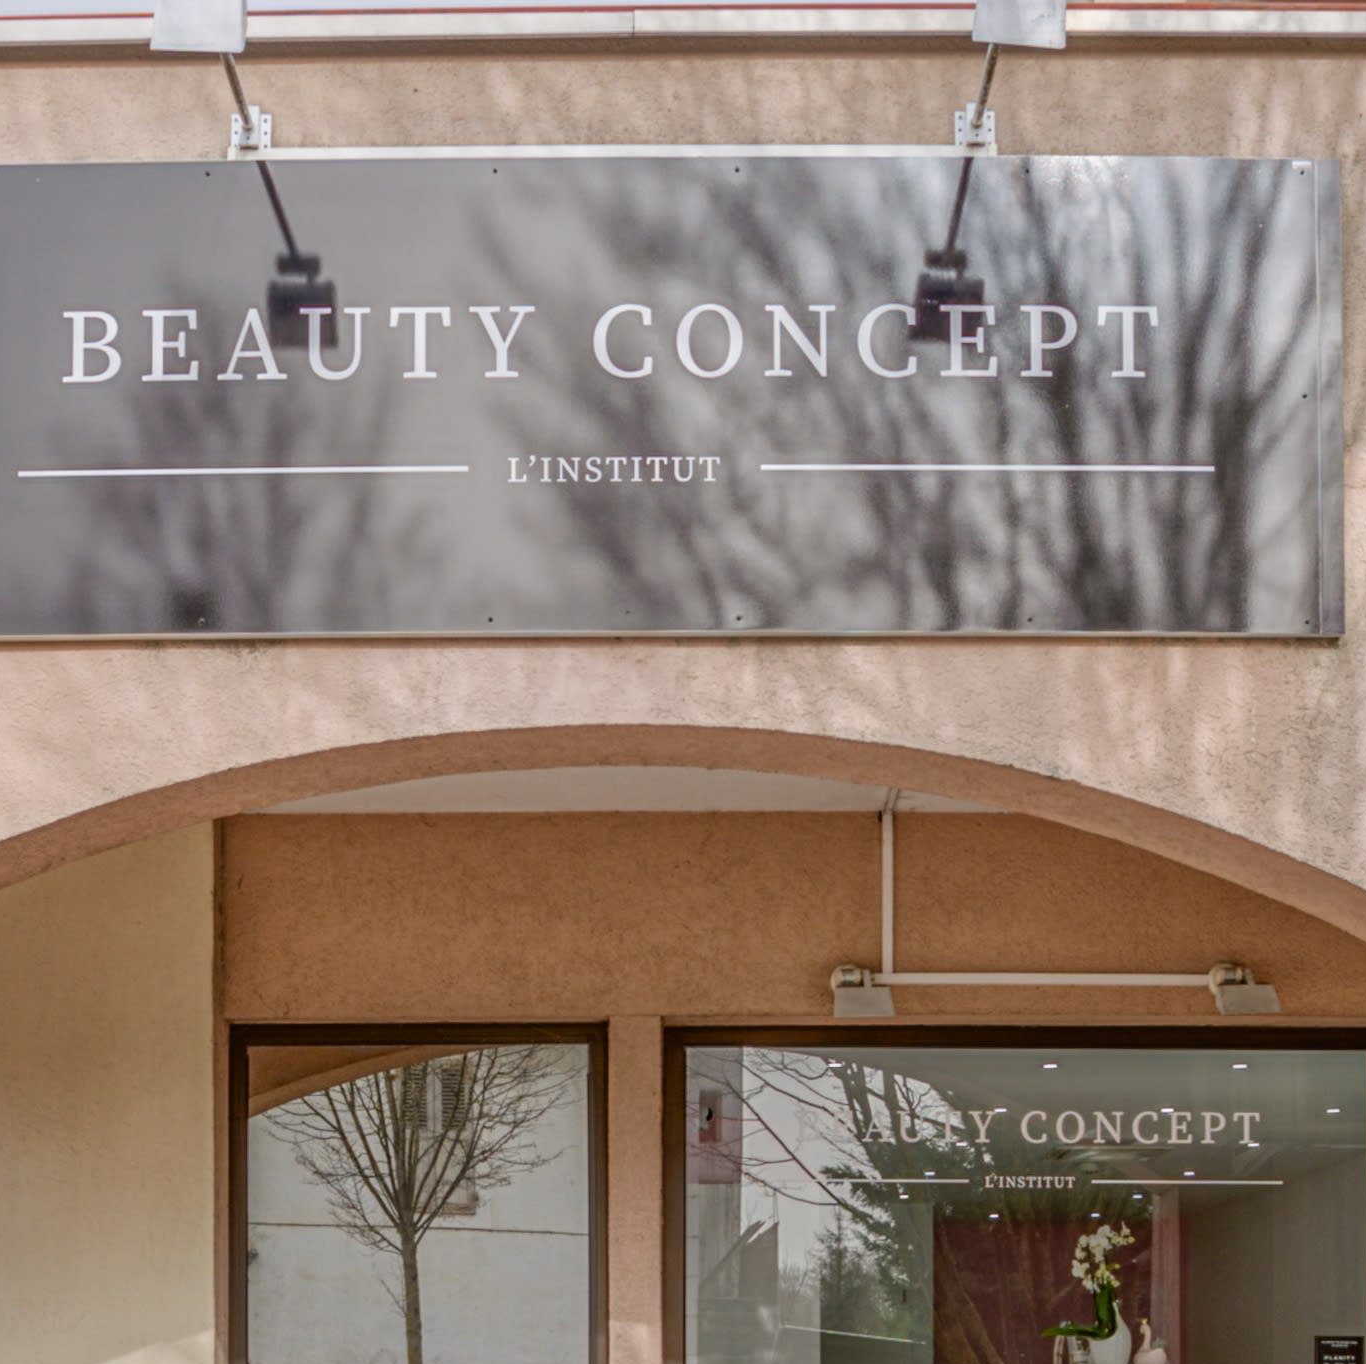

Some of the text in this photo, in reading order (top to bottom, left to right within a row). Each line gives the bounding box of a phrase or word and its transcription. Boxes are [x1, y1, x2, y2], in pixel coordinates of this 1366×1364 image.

[62, 303, 1162, 384] BEAUTY CONCEPT
[507, 452, 722, 486] L'INSTITUT
[795, 1109, 1262, 1145] BAUTY CONCEPT
[984, 1174, 1076, 1190] L'INSTITUT
